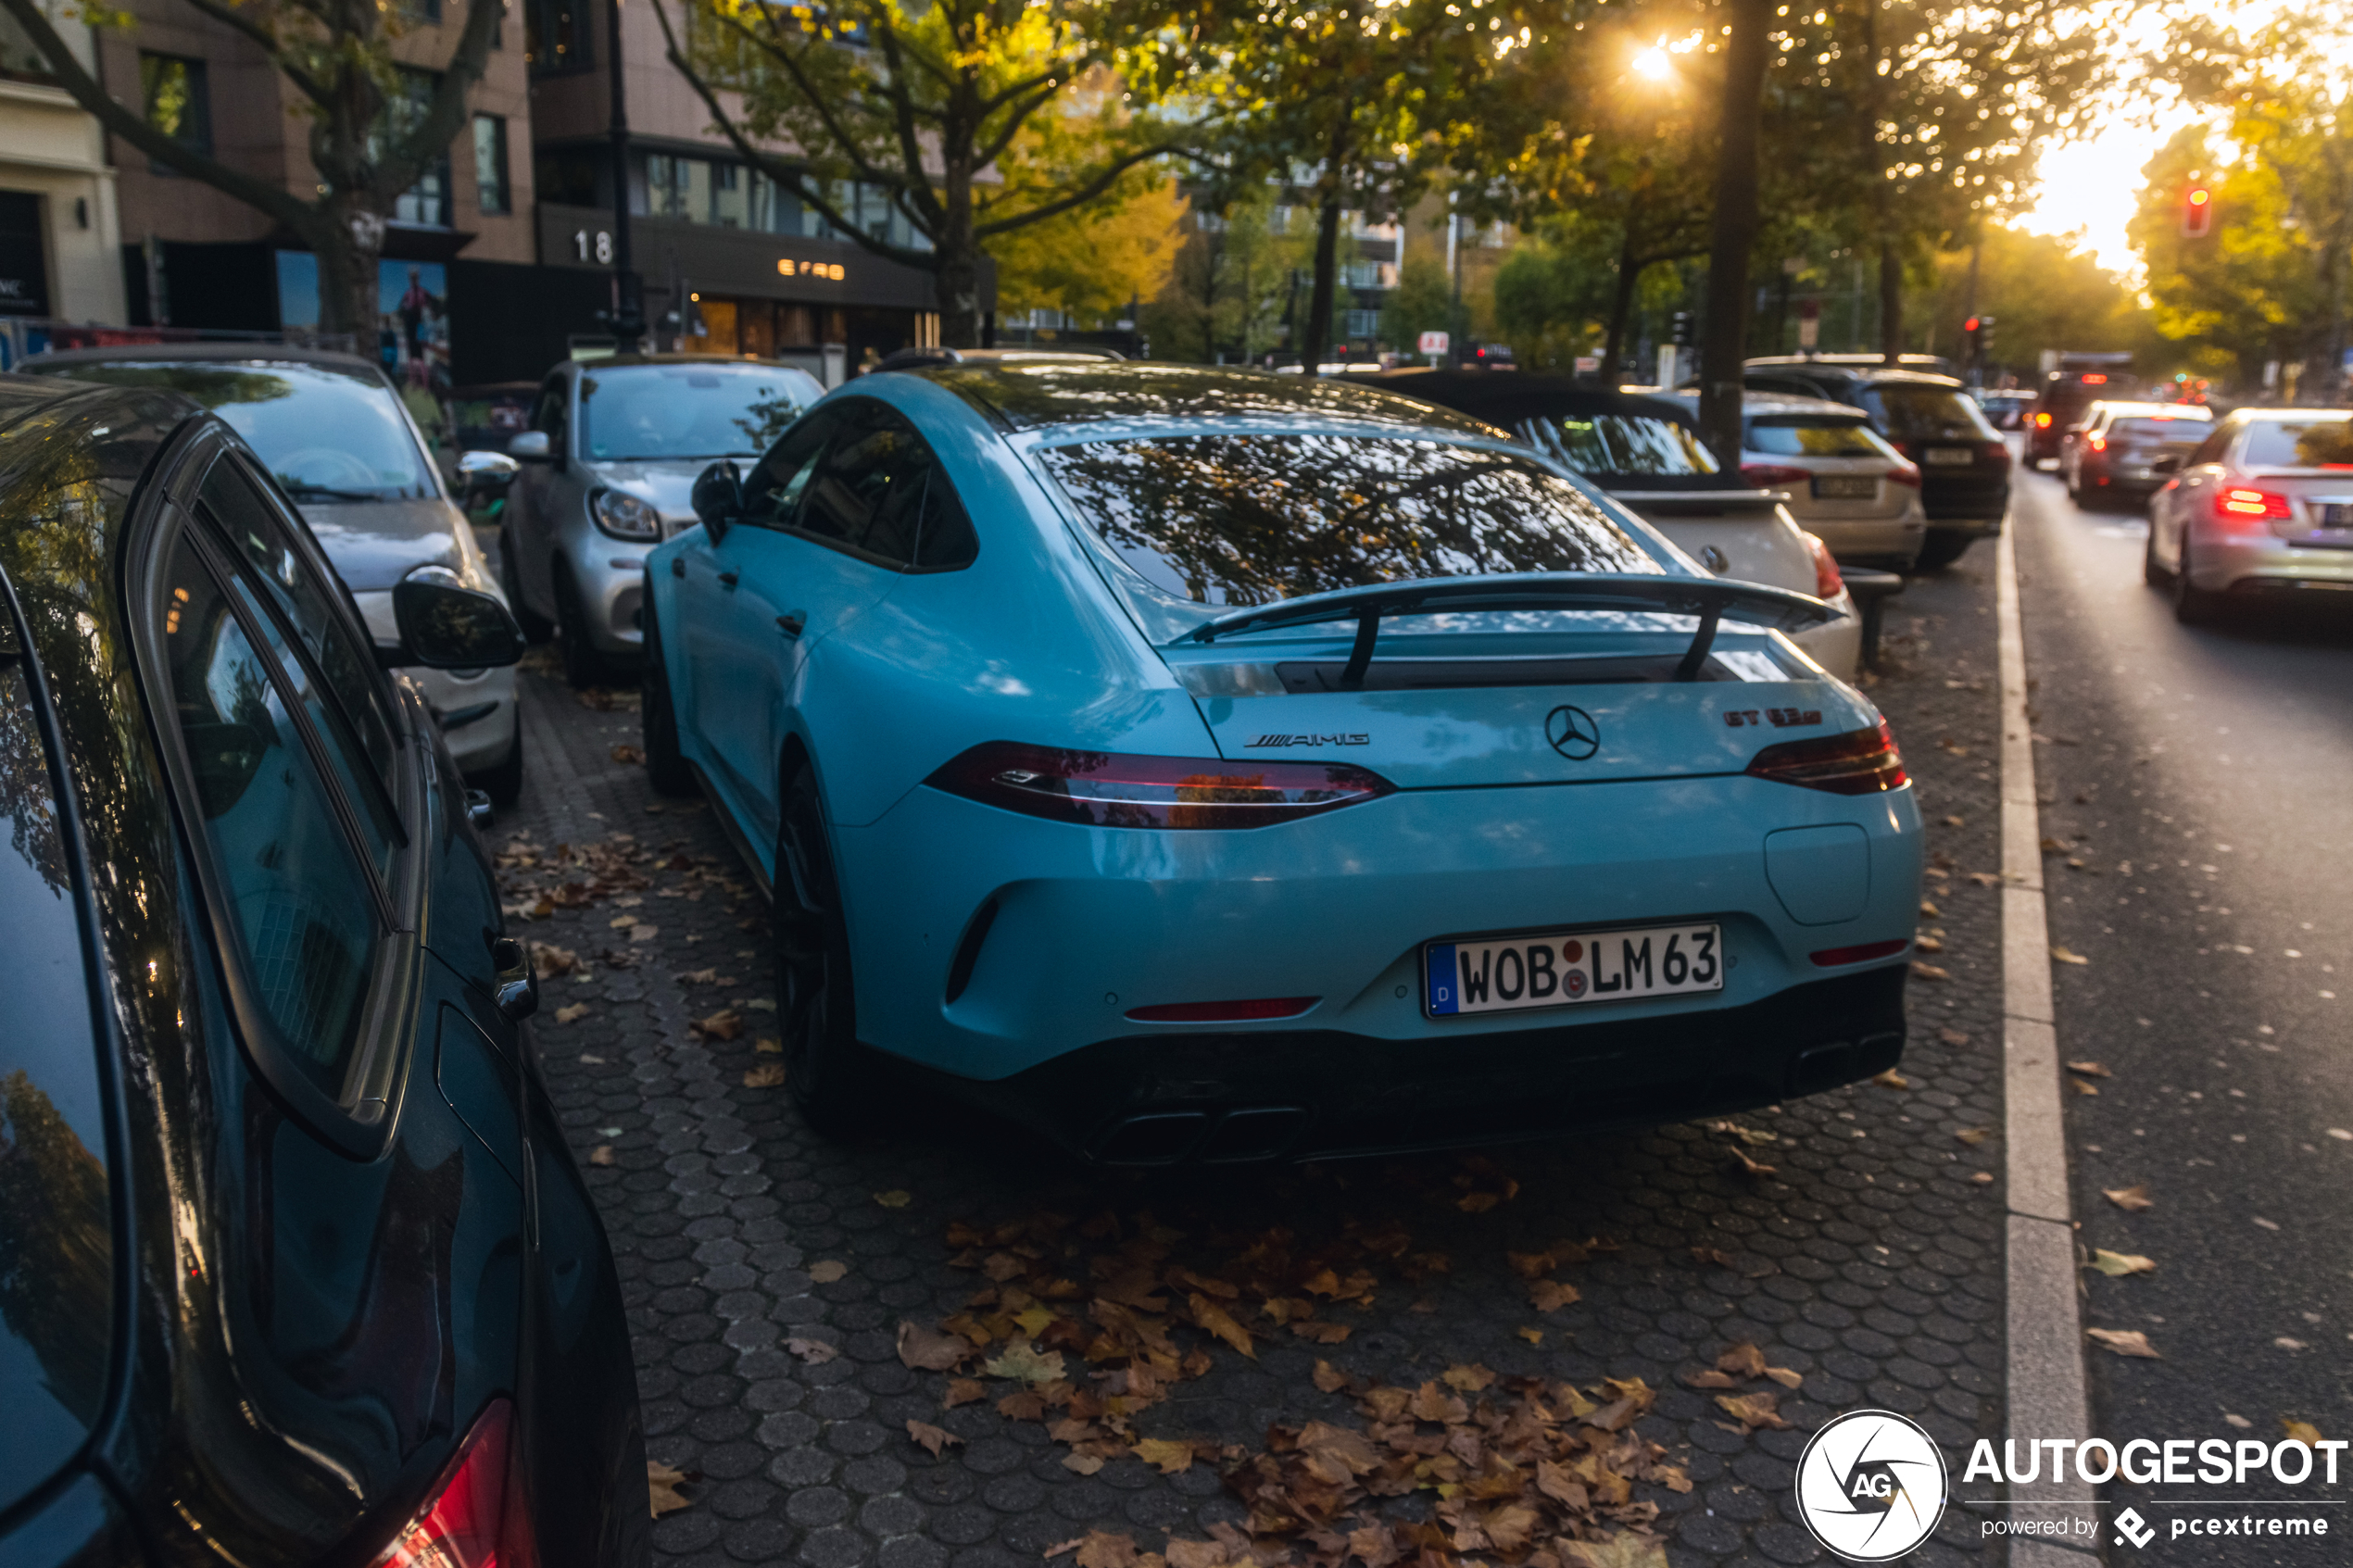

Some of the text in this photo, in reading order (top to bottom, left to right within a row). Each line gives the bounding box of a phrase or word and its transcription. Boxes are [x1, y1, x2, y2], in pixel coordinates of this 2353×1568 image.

[574, 230, 612, 264] 18
[1460, 932, 1718, 1004] WOB LM 63
[1438, 986, 1450, 1003] D
